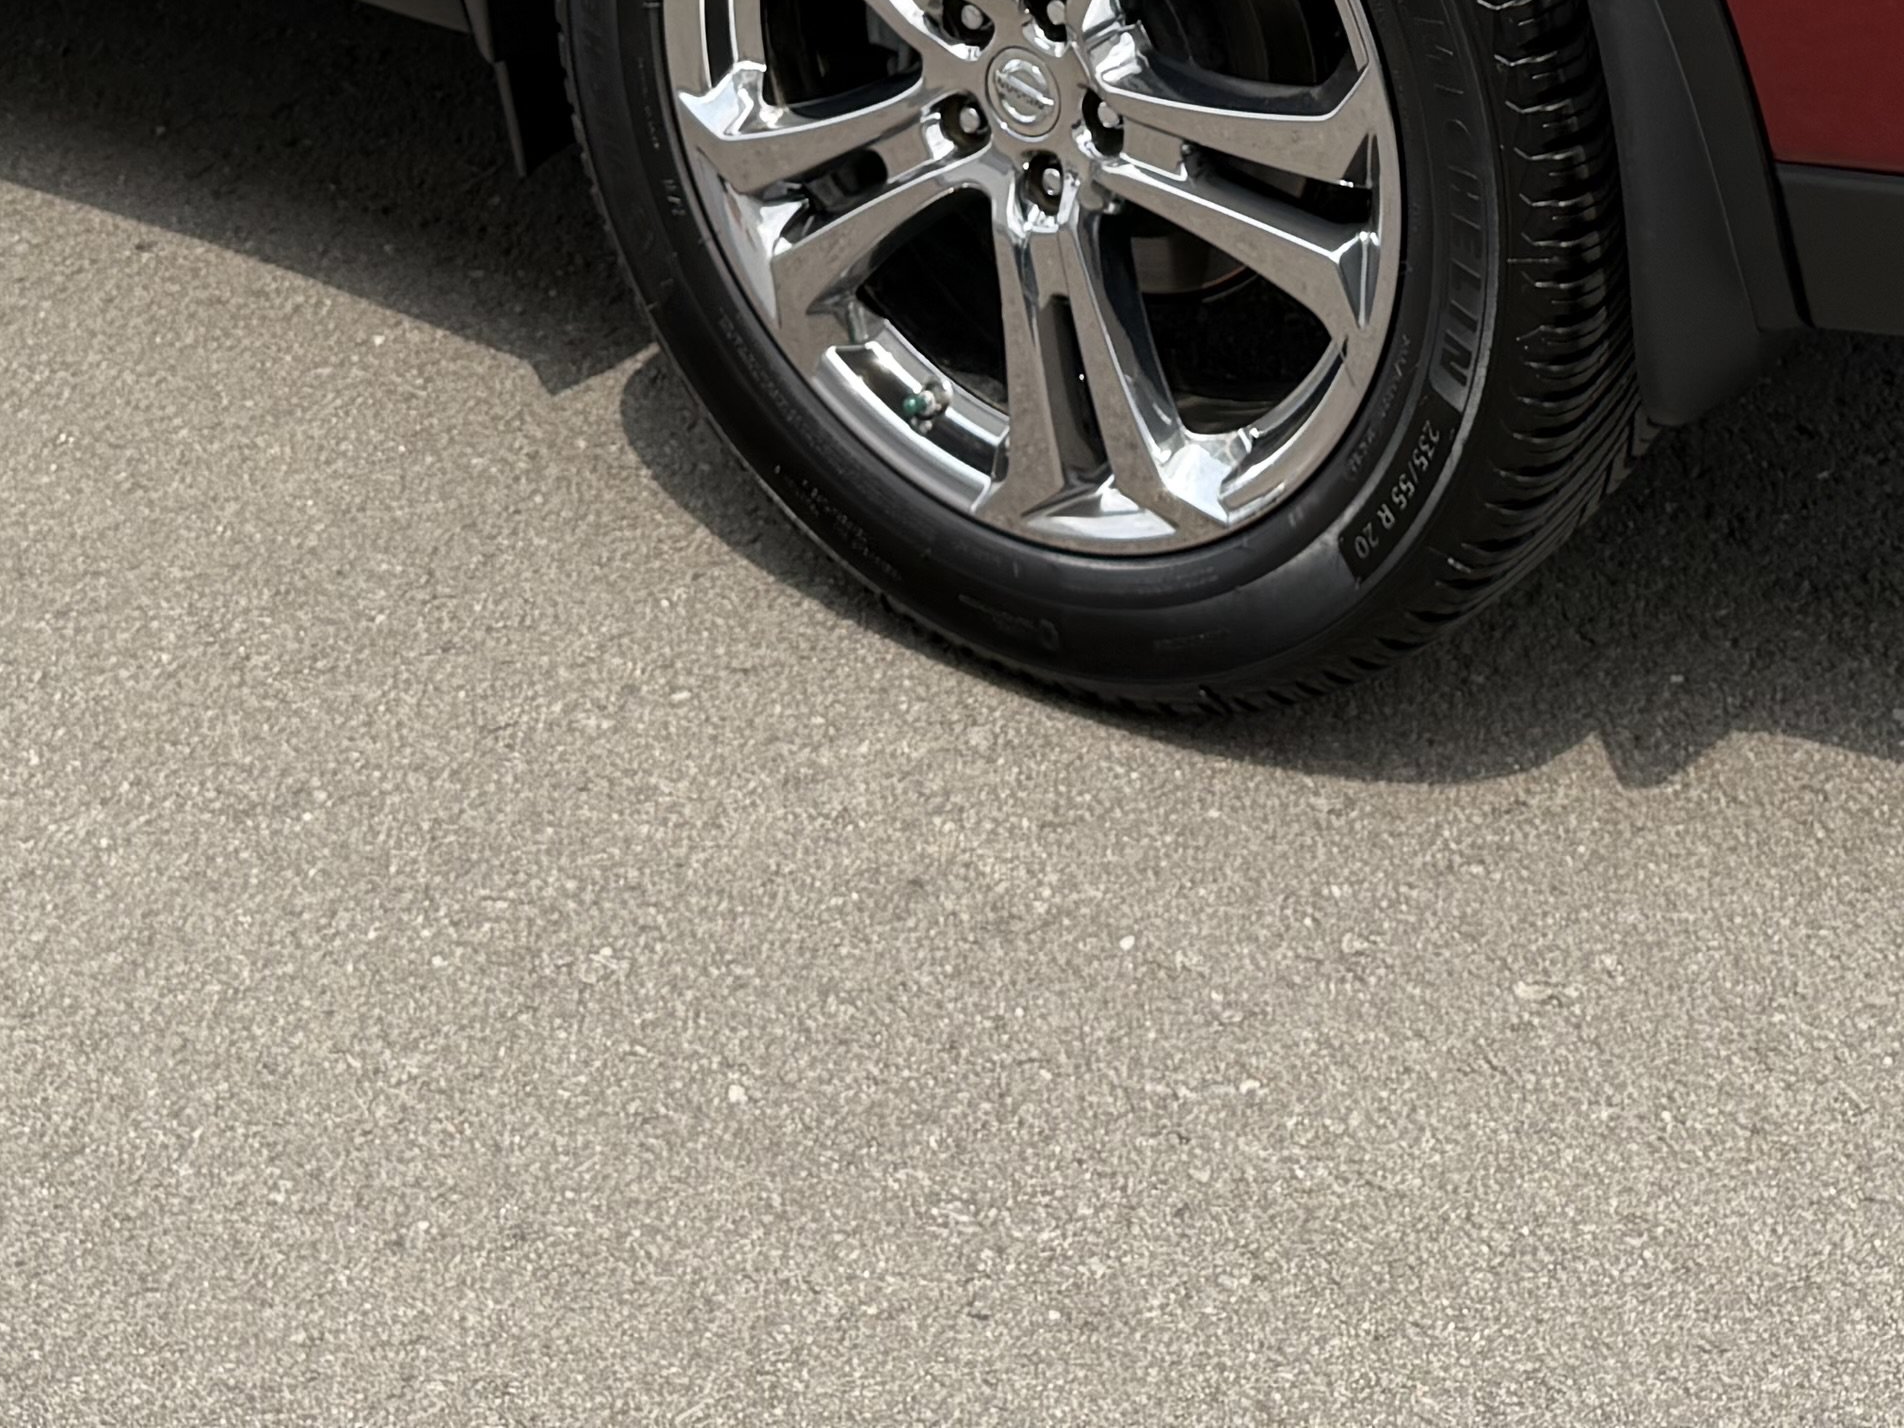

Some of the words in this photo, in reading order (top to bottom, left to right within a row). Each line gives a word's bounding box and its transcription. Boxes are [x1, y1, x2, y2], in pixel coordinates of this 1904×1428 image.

[1391, 419, 1440, 510] 235/55
[1376, 503, 1396, 530] R
[1353, 521, 1380, 560] 20
